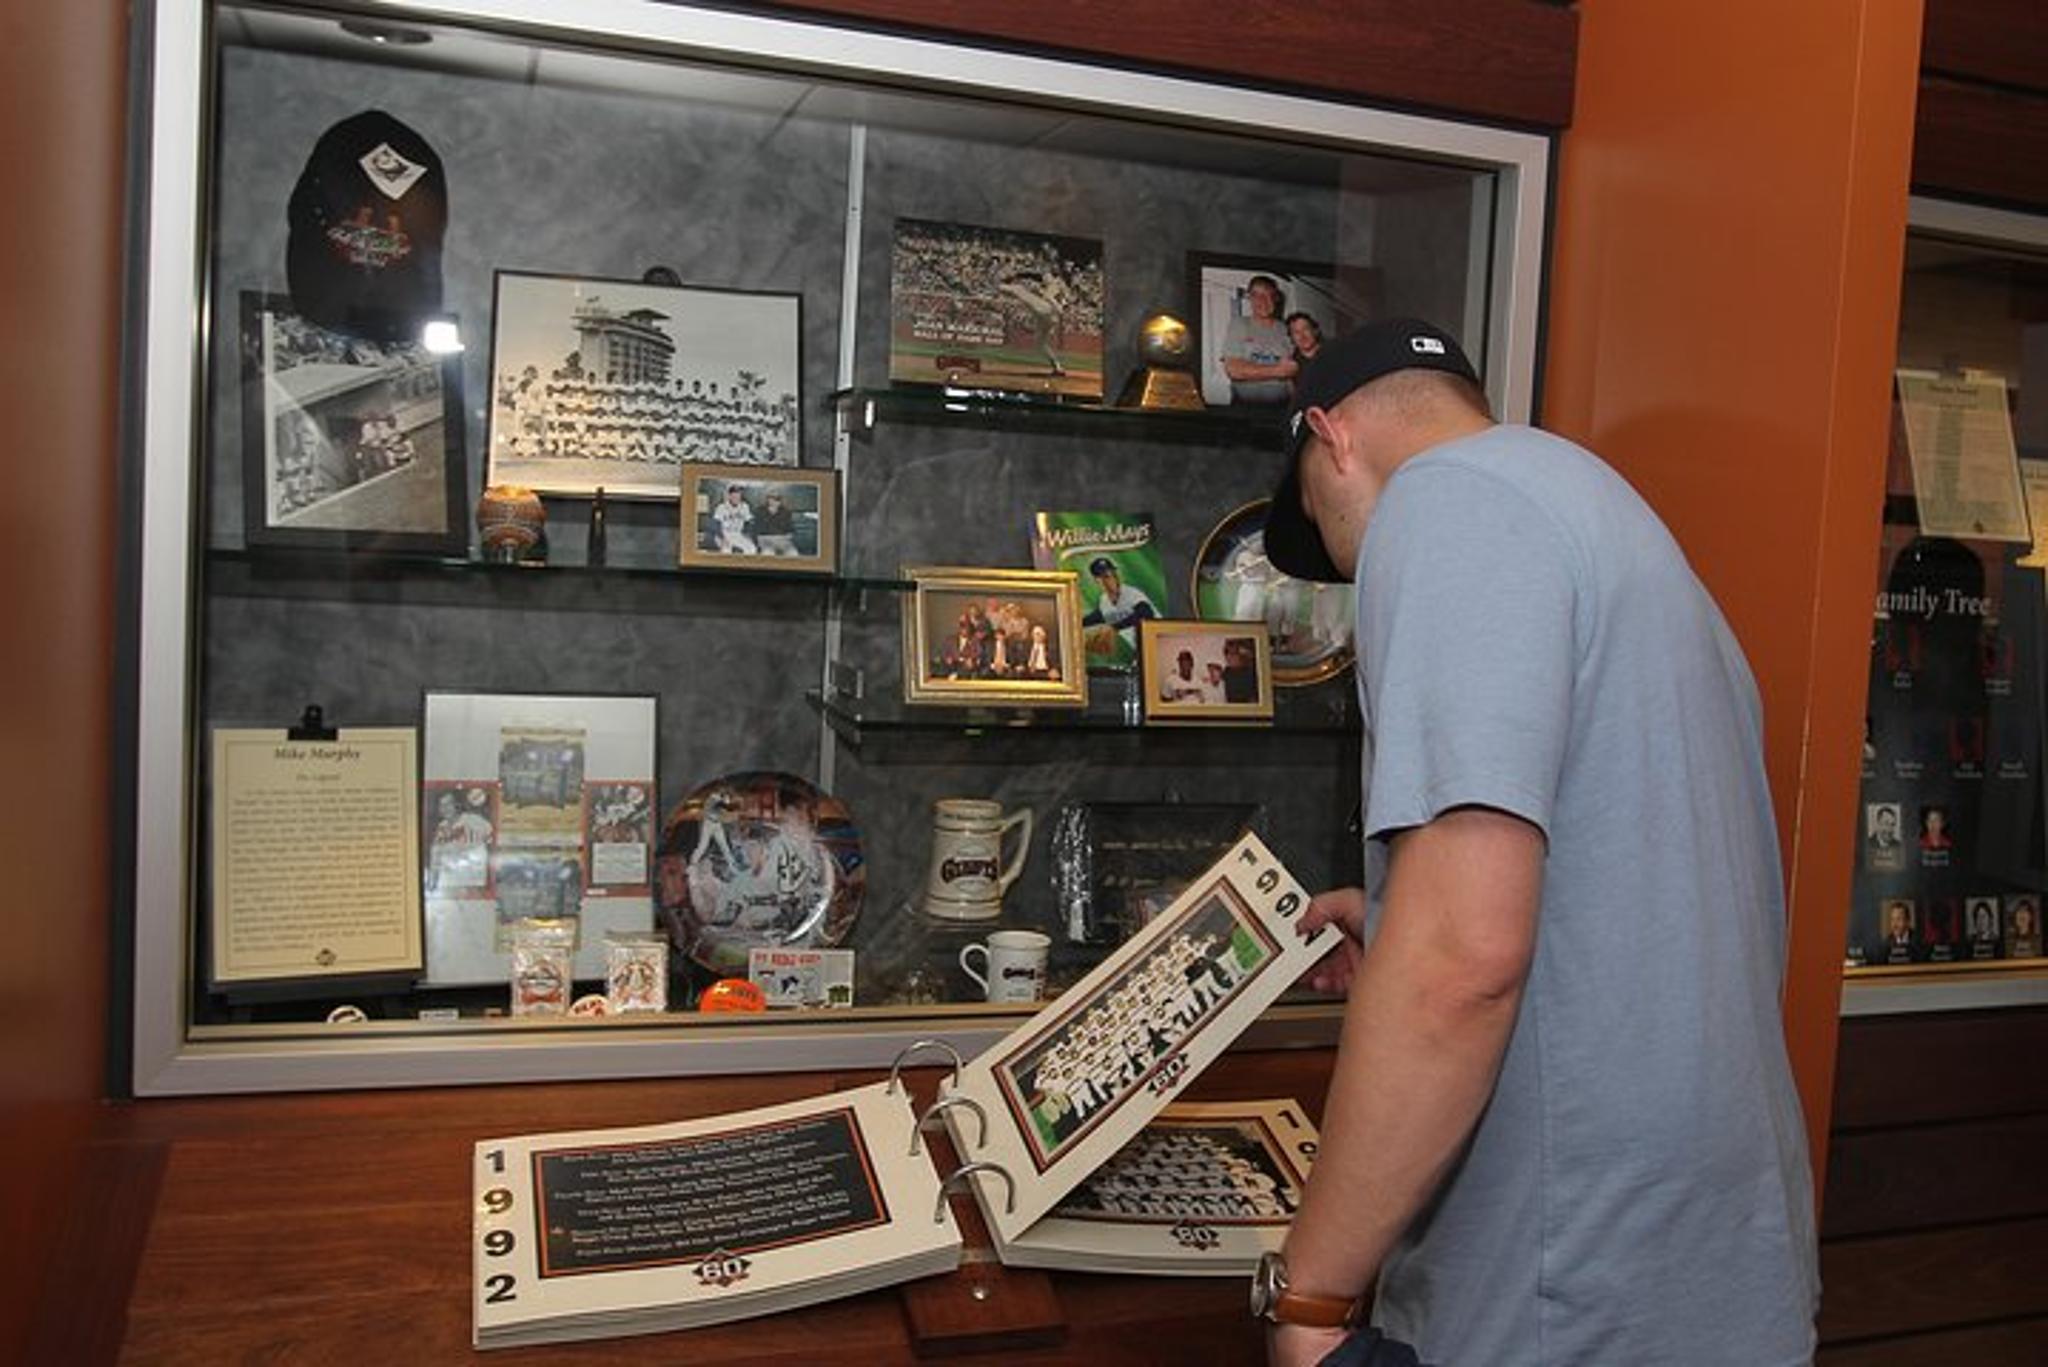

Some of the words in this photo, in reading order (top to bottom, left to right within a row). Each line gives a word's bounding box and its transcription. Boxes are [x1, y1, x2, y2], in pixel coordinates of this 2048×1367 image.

[1047, 526, 1101, 548] Willie
[1103, 522, 1152, 546] Mays
[1875, 584, 1939, 622] amily
[1944, 586, 1993, 617] Tree
[275, 747, 305, 759] Mike
[310, 746, 361, 761] Murphy
